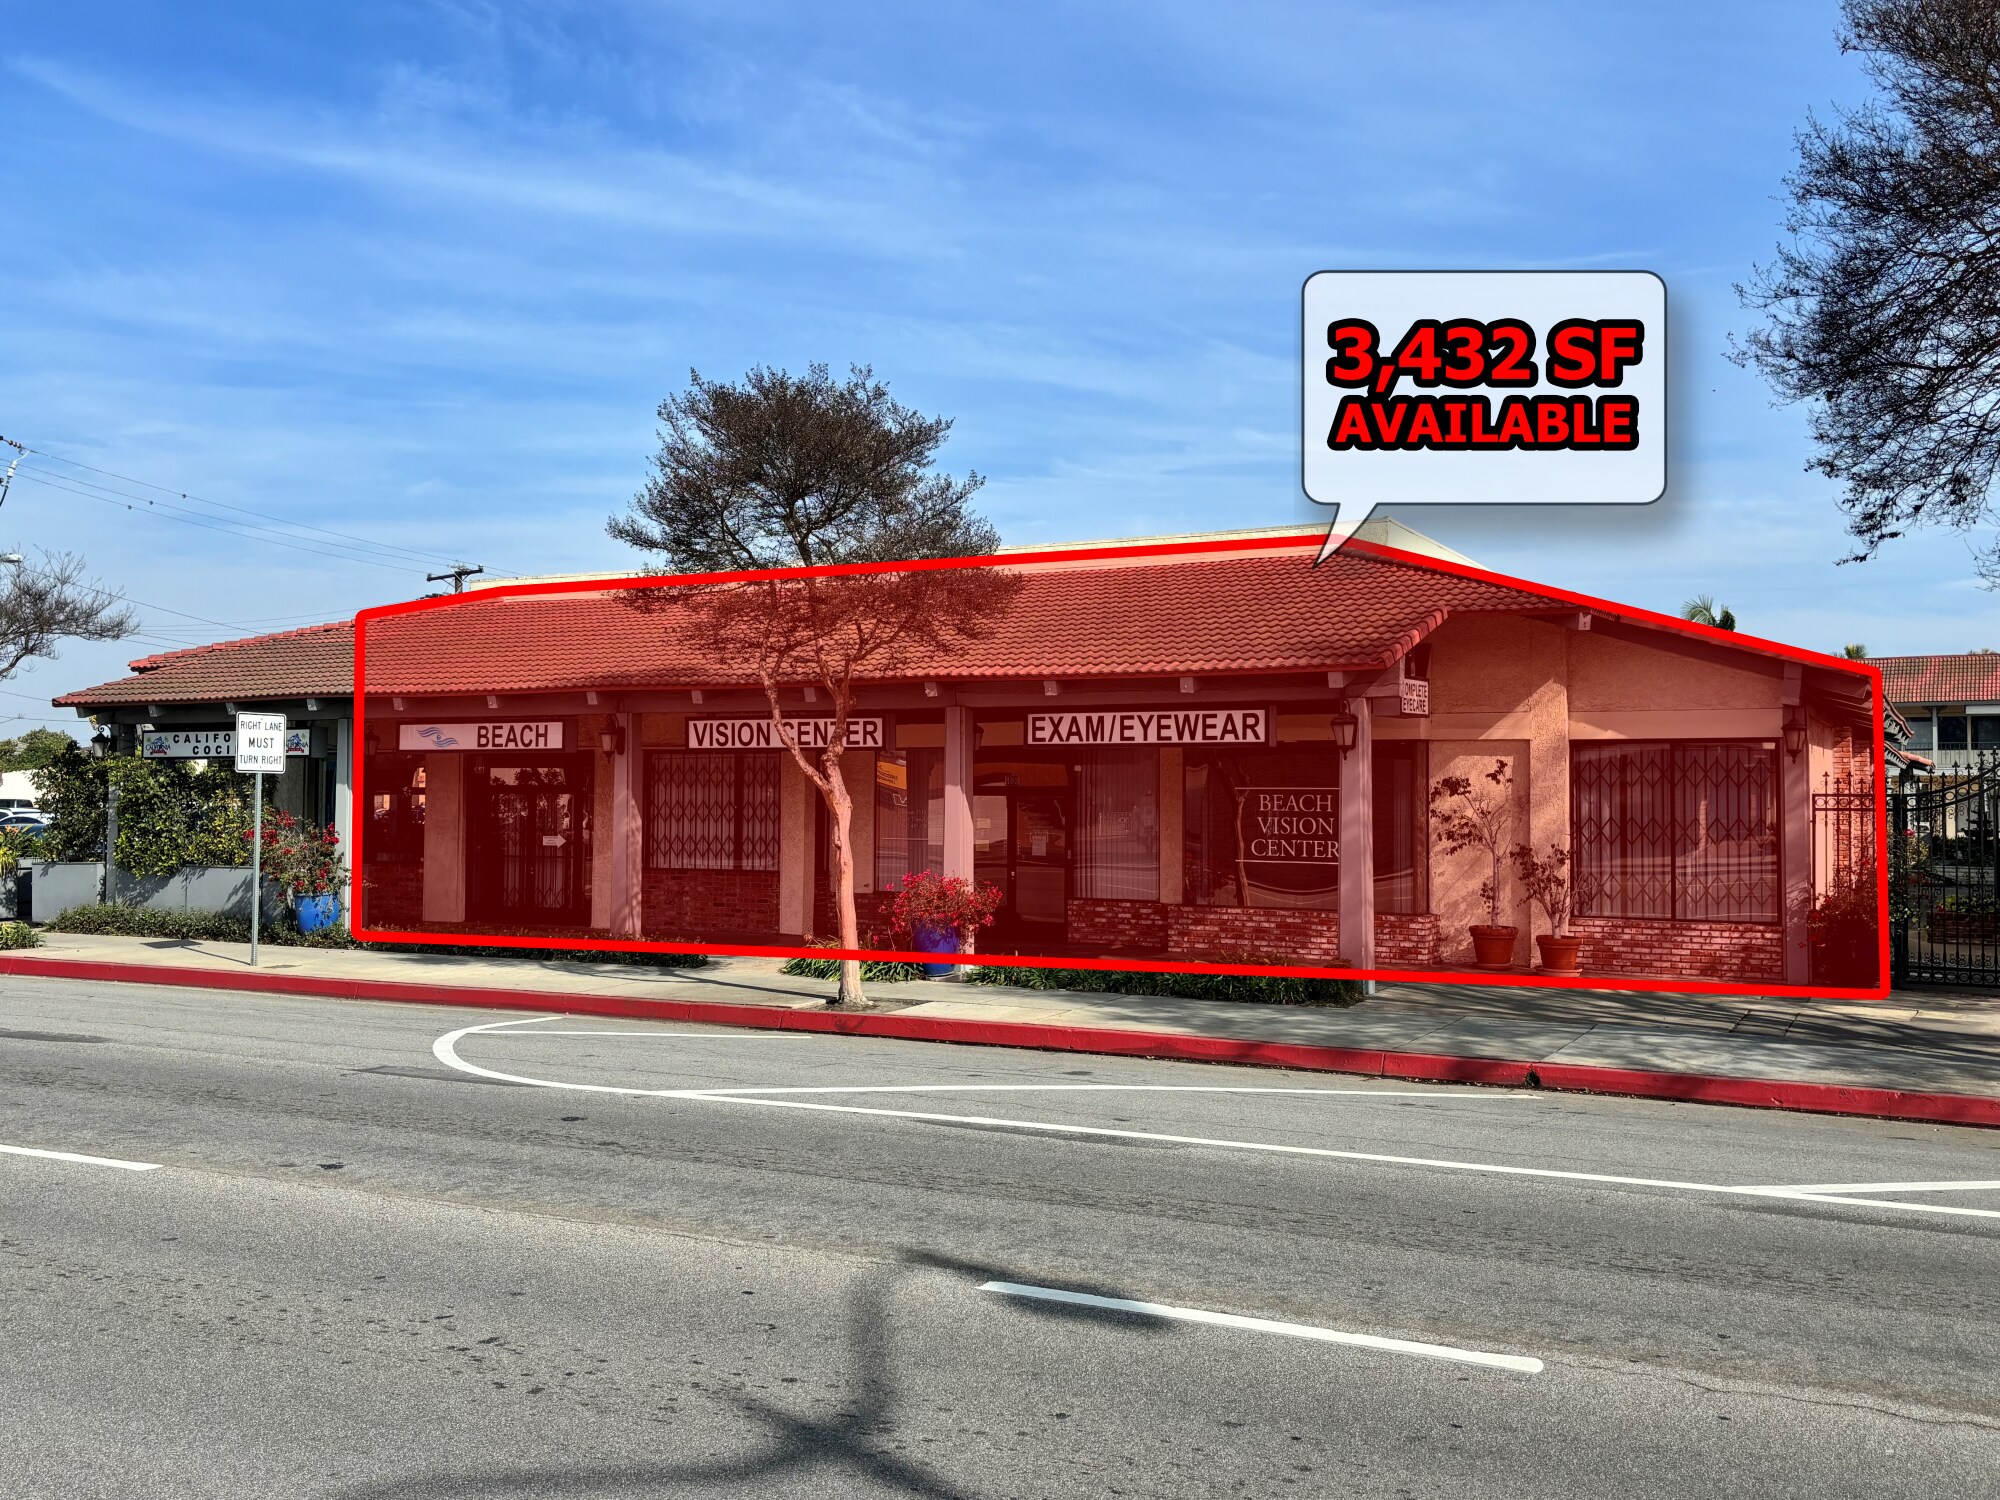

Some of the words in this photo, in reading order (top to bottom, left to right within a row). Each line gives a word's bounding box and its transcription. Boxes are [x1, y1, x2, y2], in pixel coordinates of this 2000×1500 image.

[1402, 682, 1428, 699] OMPLETE
[1402, 697, 1427, 713] EYECARE
[240, 720, 262, 730] RIGHT
[264, 721, 283, 732] LANE
[693, 722, 771, 747] VISION
[1031, 712, 1261, 743] EXAM/EYEWEAR
[173, 733, 231, 744] CALIFO
[248, 737, 275, 749] MUST
[477, 724, 548, 748] BEACH
[192, 745, 236, 755] COCI
[239, 754, 259, 764] TURN
[261, 755, 282, 765] RIGHT
[1258, 794, 1333, 812] BEACH
[1256, 816, 1335, 835] VISION
[1251, 838, 1340, 858] CENTER
